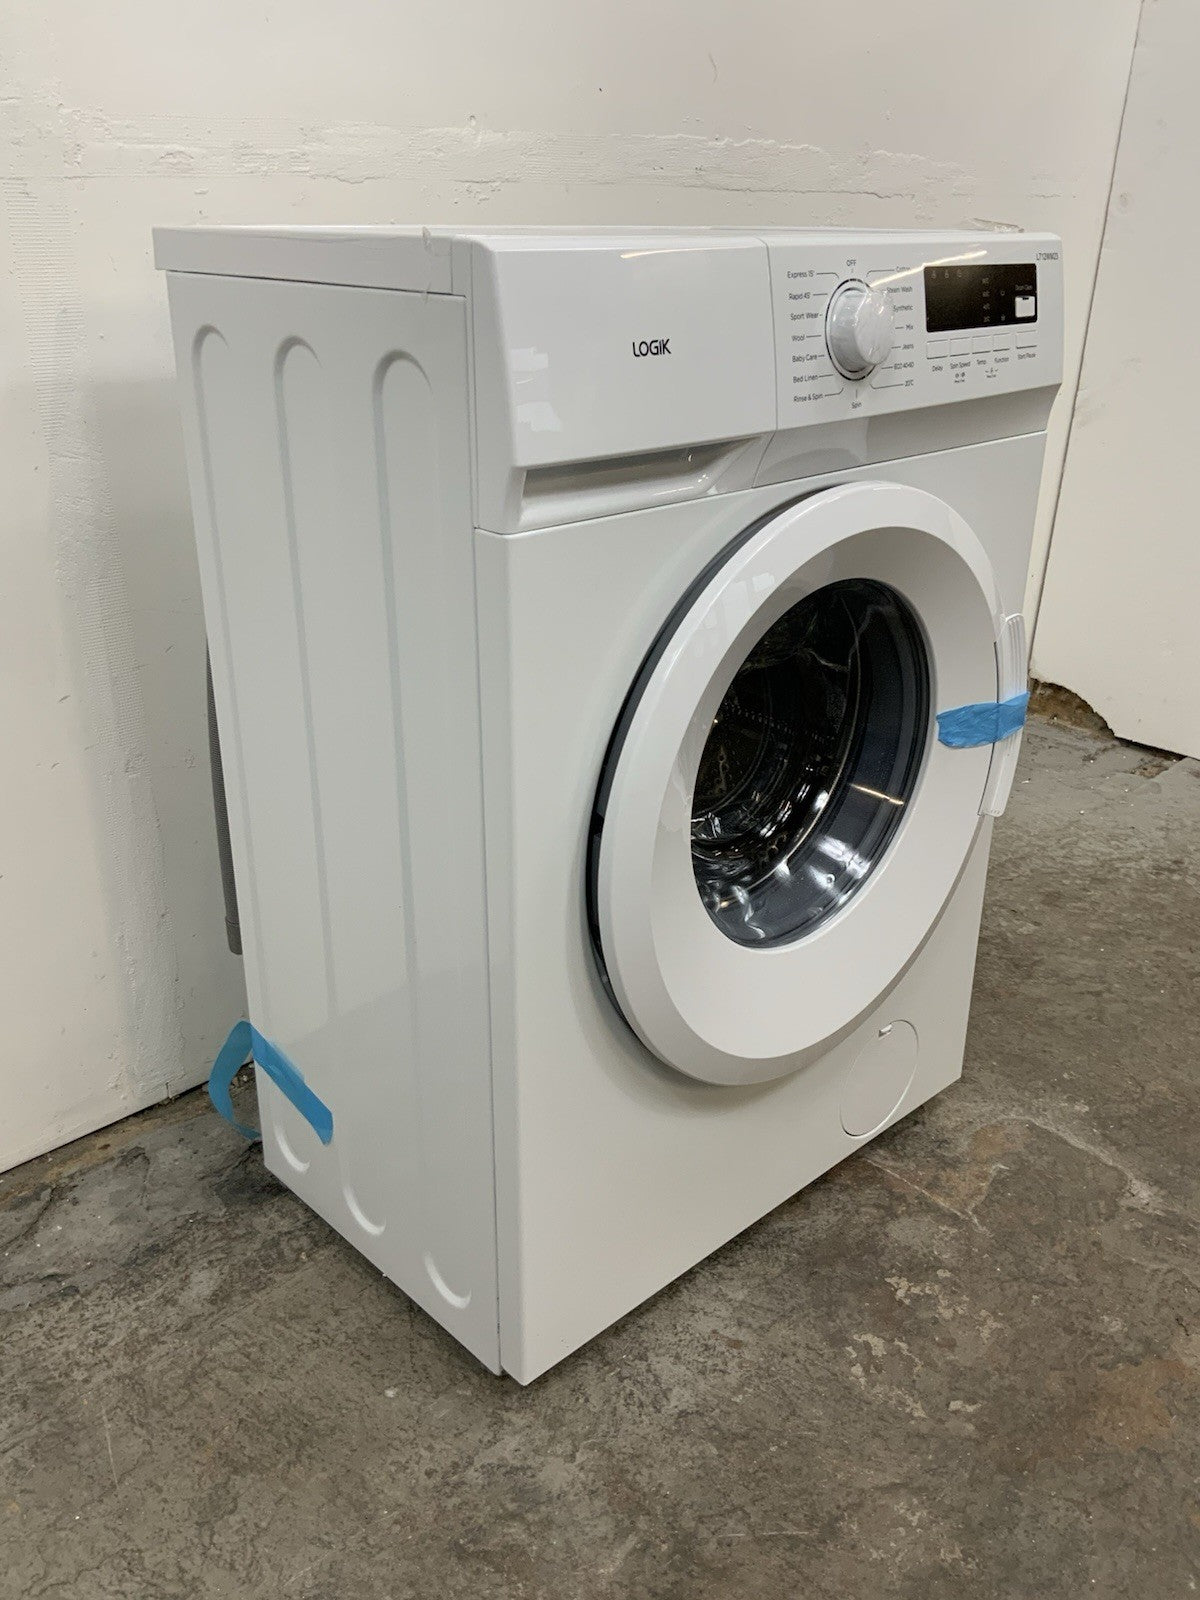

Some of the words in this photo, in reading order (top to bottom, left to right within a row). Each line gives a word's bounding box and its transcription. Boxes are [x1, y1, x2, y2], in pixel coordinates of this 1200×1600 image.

[787, 270, 808, 279] Express
[893, 304, 914, 313] Synthetic
[790, 312, 804, 321] Sport
[632, 338, 672, 358] LOGIK
[792, 355, 804, 363] Baby
[806, 354, 818, 362] Care
[959, 361, 971, 369] Speed
[793, 376, 804, 384] Bed
[804, 374, 818, 382] Linen
[812, 393, 824, 401] Spin
